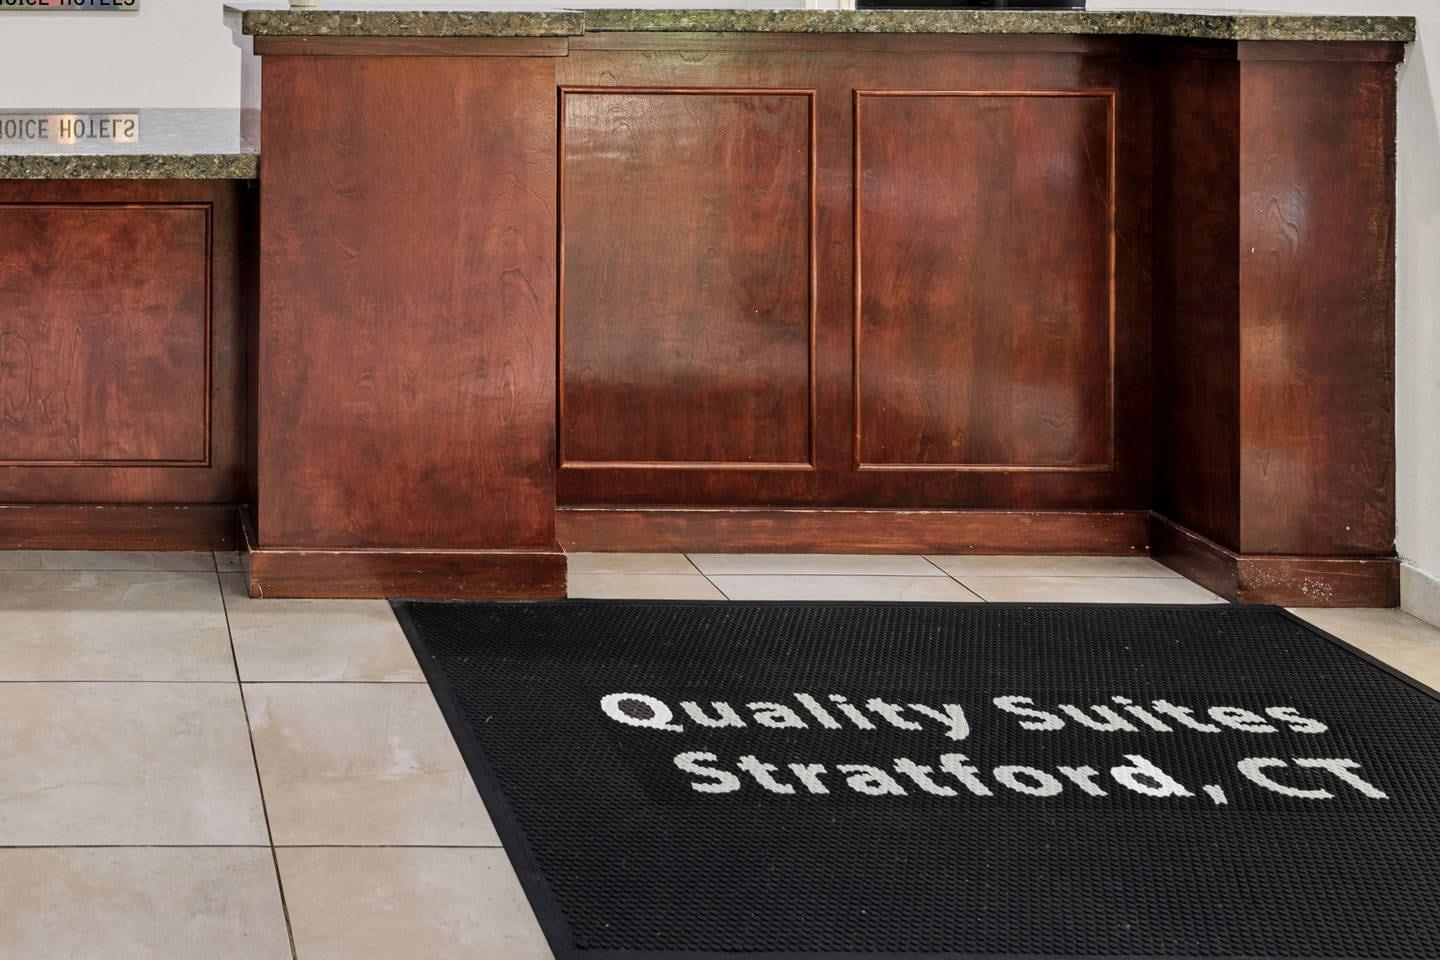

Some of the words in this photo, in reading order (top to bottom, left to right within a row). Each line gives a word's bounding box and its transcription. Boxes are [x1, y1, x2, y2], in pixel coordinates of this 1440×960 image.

[599, 692, 970, 741] Quality
[992, 695, 1329, 734] Suites
[673, 751, 1228, 805] Stratford,
[1237, 757, 1390, 800] CT
